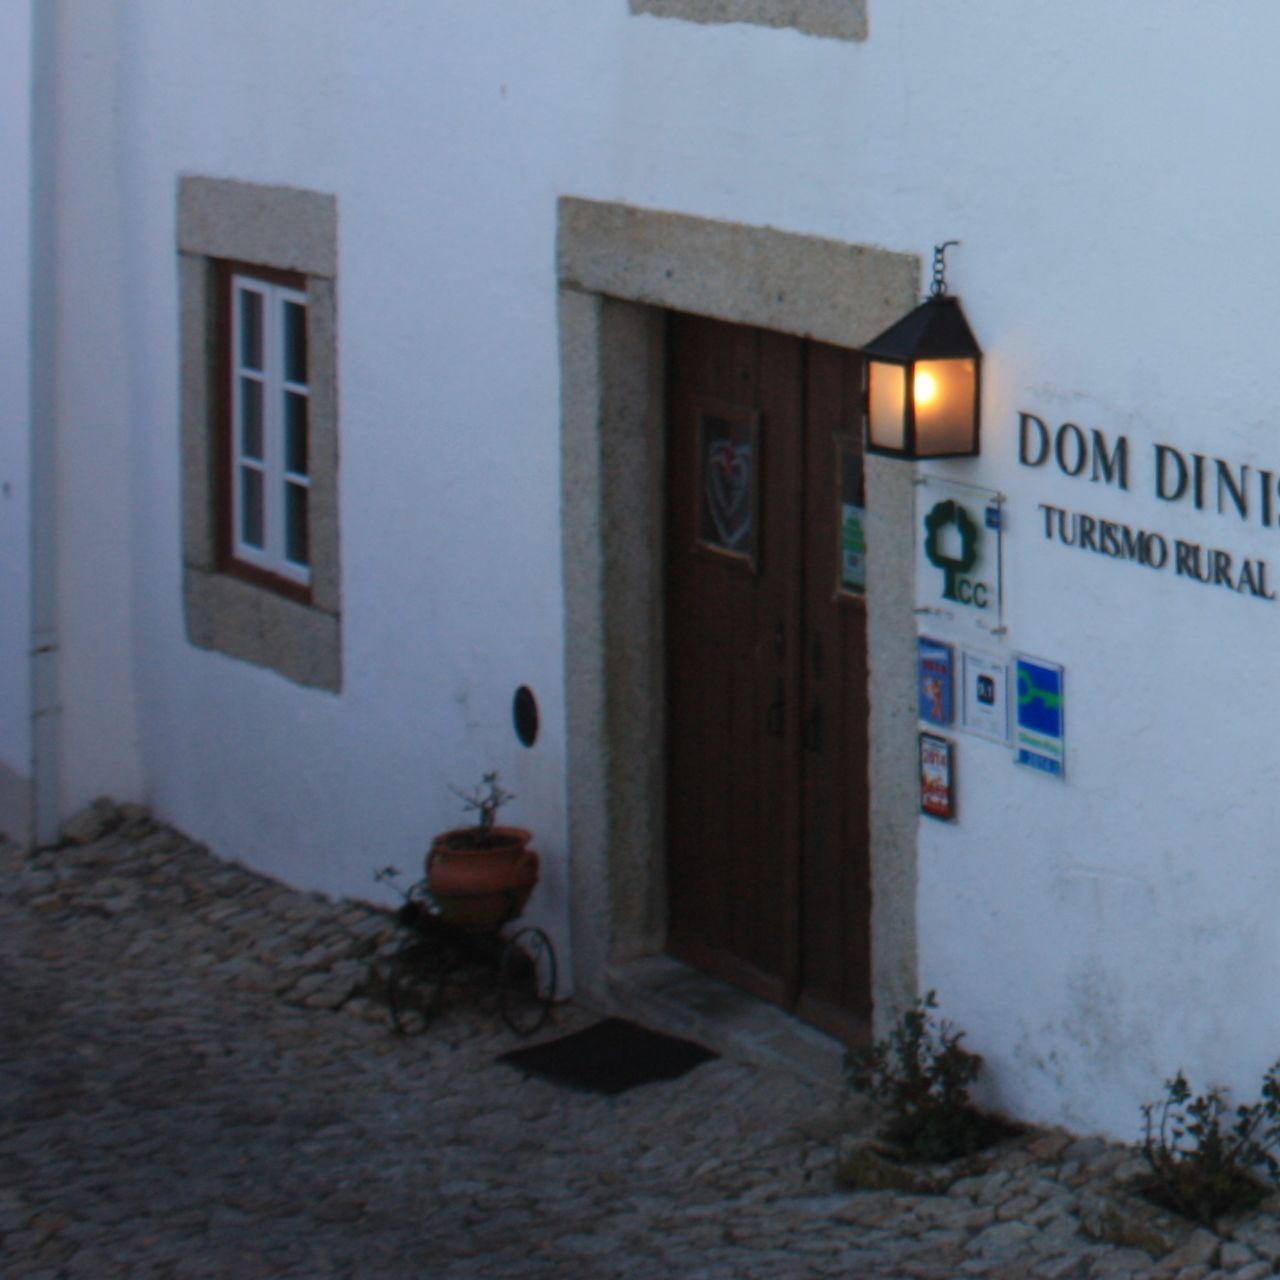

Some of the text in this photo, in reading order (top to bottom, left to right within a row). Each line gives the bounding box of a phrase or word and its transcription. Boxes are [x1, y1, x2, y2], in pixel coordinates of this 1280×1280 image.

[1018, 411, 1129, 491] DOM
[1039, 504, 1277, 601] TURISMO RURAL
